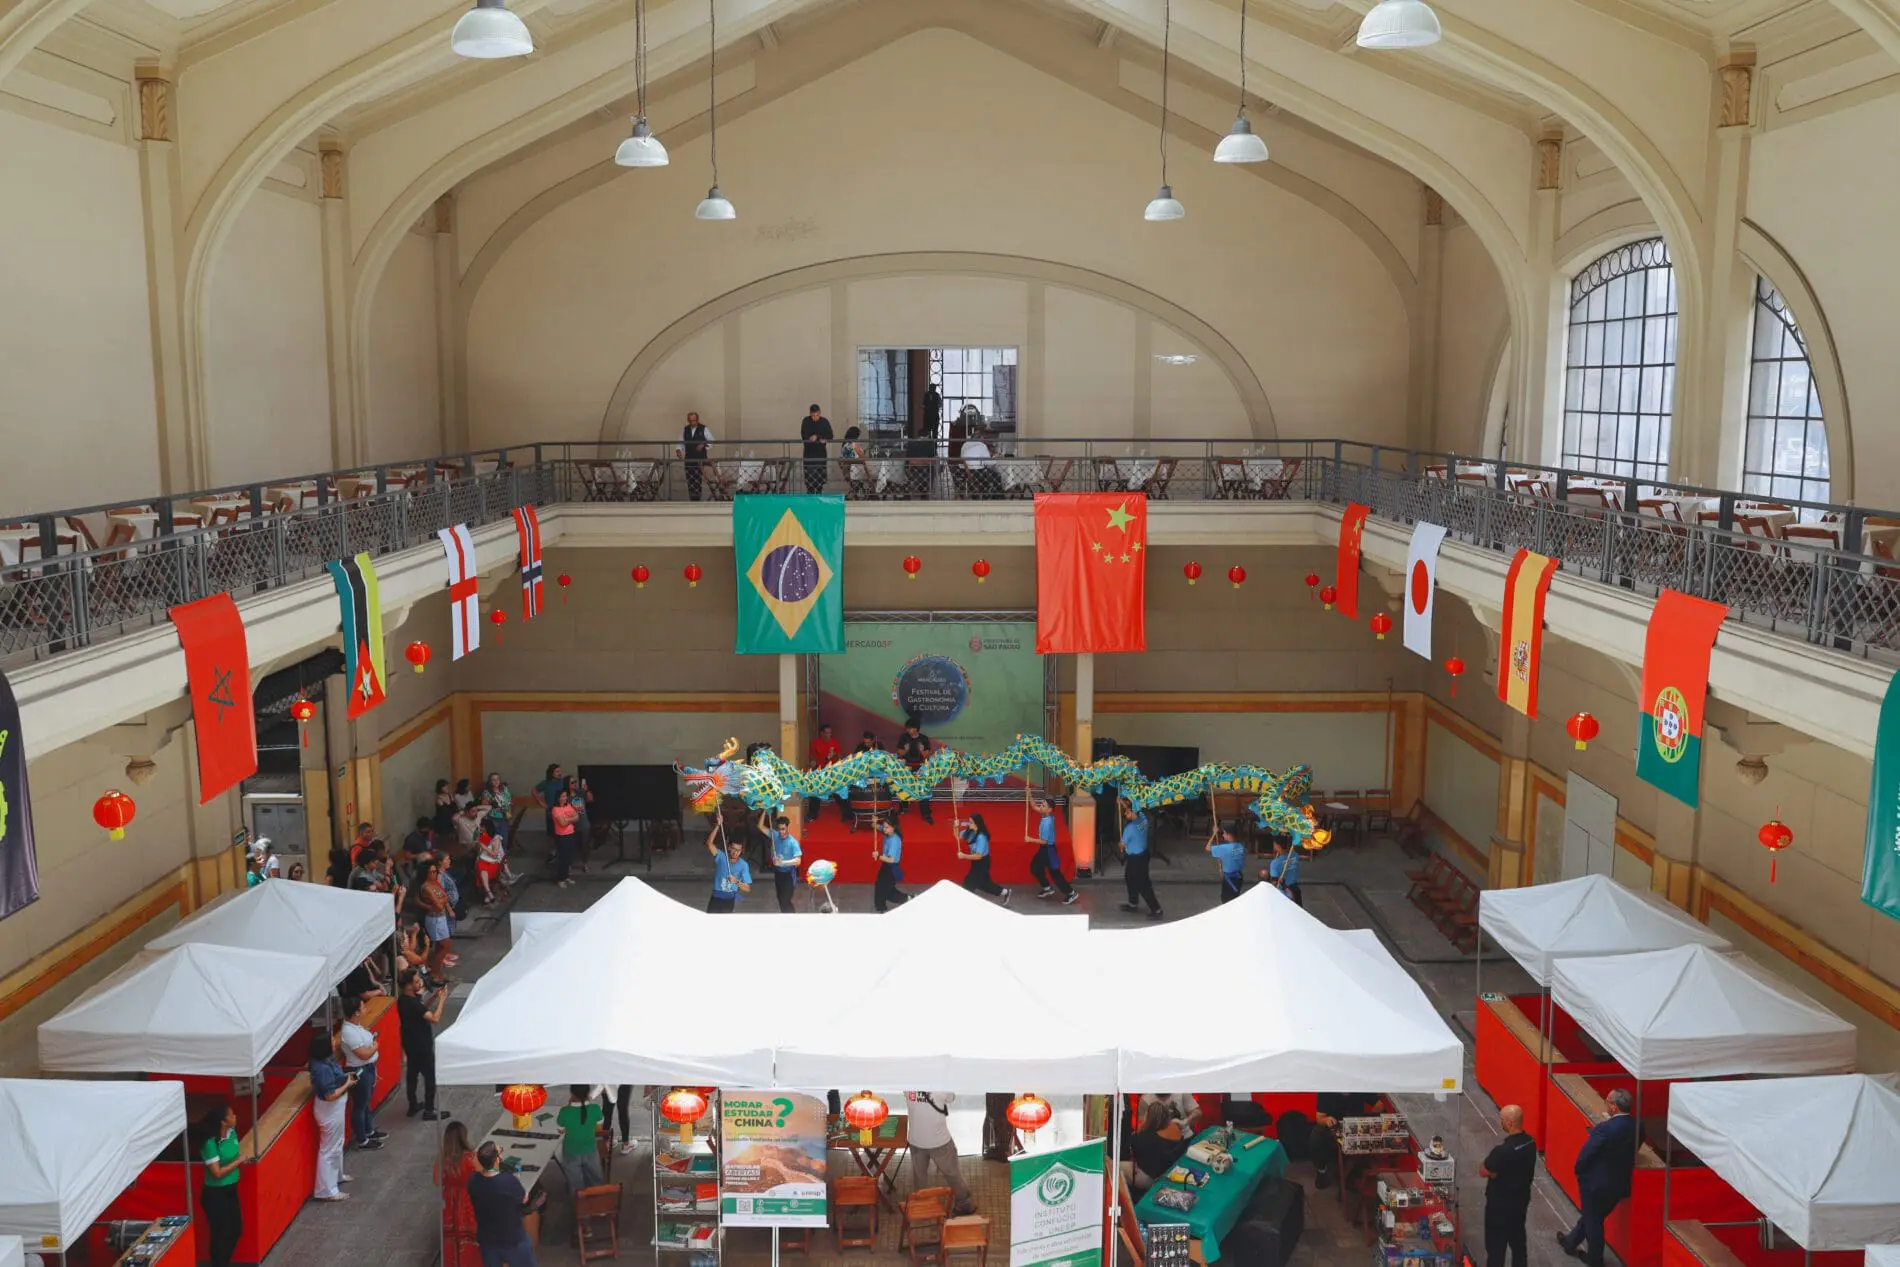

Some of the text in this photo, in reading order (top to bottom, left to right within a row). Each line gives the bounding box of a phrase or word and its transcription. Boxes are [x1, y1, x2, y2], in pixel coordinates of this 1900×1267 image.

[724, 1100, 763, 1109] MORAR
[724, 1109, 773, 1117] ESTUDAR
[734, 1118, 773, 1128] CHINA
